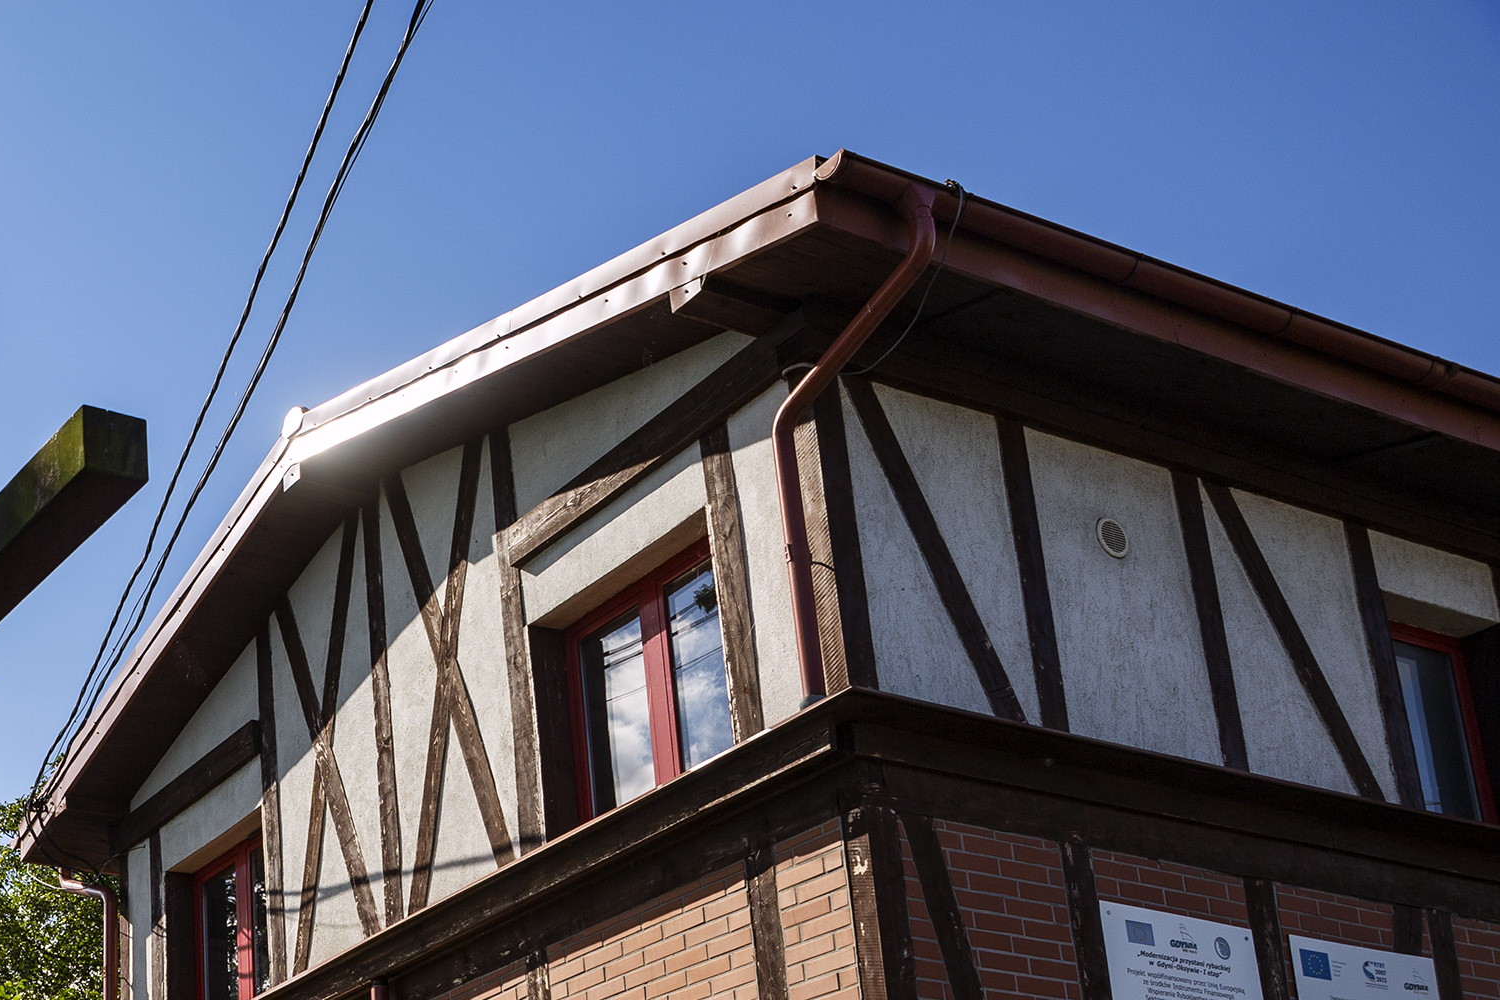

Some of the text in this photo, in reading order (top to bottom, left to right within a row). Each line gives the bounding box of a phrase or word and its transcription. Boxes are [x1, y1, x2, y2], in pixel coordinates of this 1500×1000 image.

[1170, 939, 1197, 950] GDYNIA
[1179, 958, 1205, 967] przystani
[1206, 963, 1231, 973] rybackiej
[1404, 982, 1429, 991] GDYNIA
